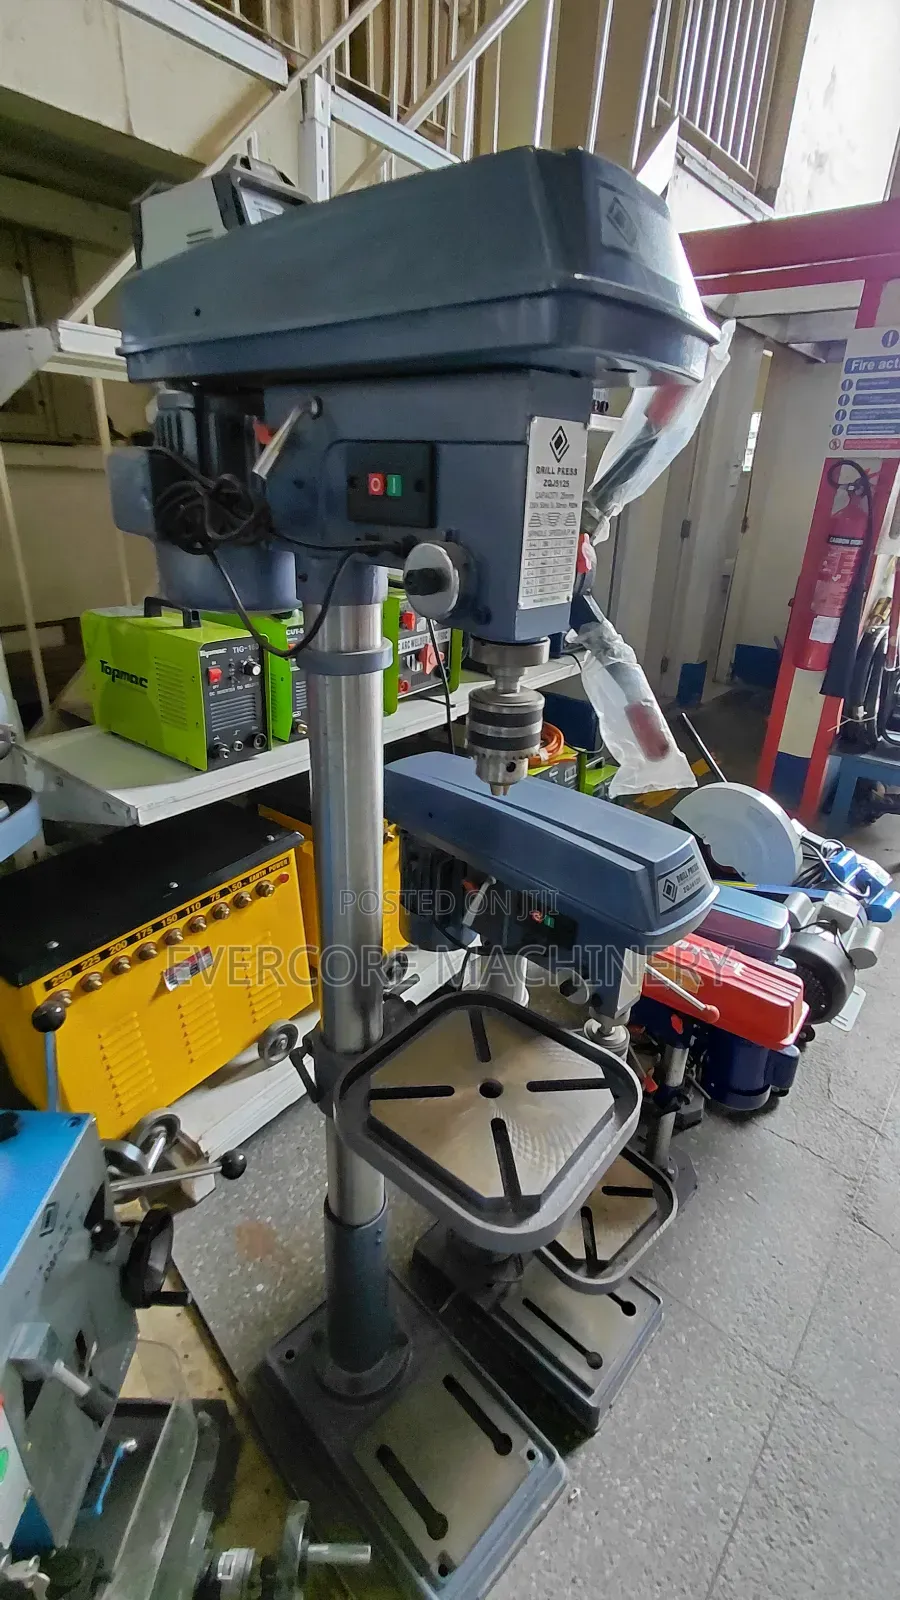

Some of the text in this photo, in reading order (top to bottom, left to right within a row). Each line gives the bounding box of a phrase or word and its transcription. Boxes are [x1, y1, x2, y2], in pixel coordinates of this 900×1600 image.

[851, 357, 900, 372] Fire act
[535, 465, 578, 476] DRILL PRESS
[100, 659, 148, 688] Topmac
[51, 970, 73, 987] 250
[80, 955, 101, 971] 225
[109, 940, 128, 955] 200
[135, 926, 154, 940] 175
[160, 913, 178, 928] 150
[185, 902, 202, 915] 110
[210, 891, 221, 903] 75
